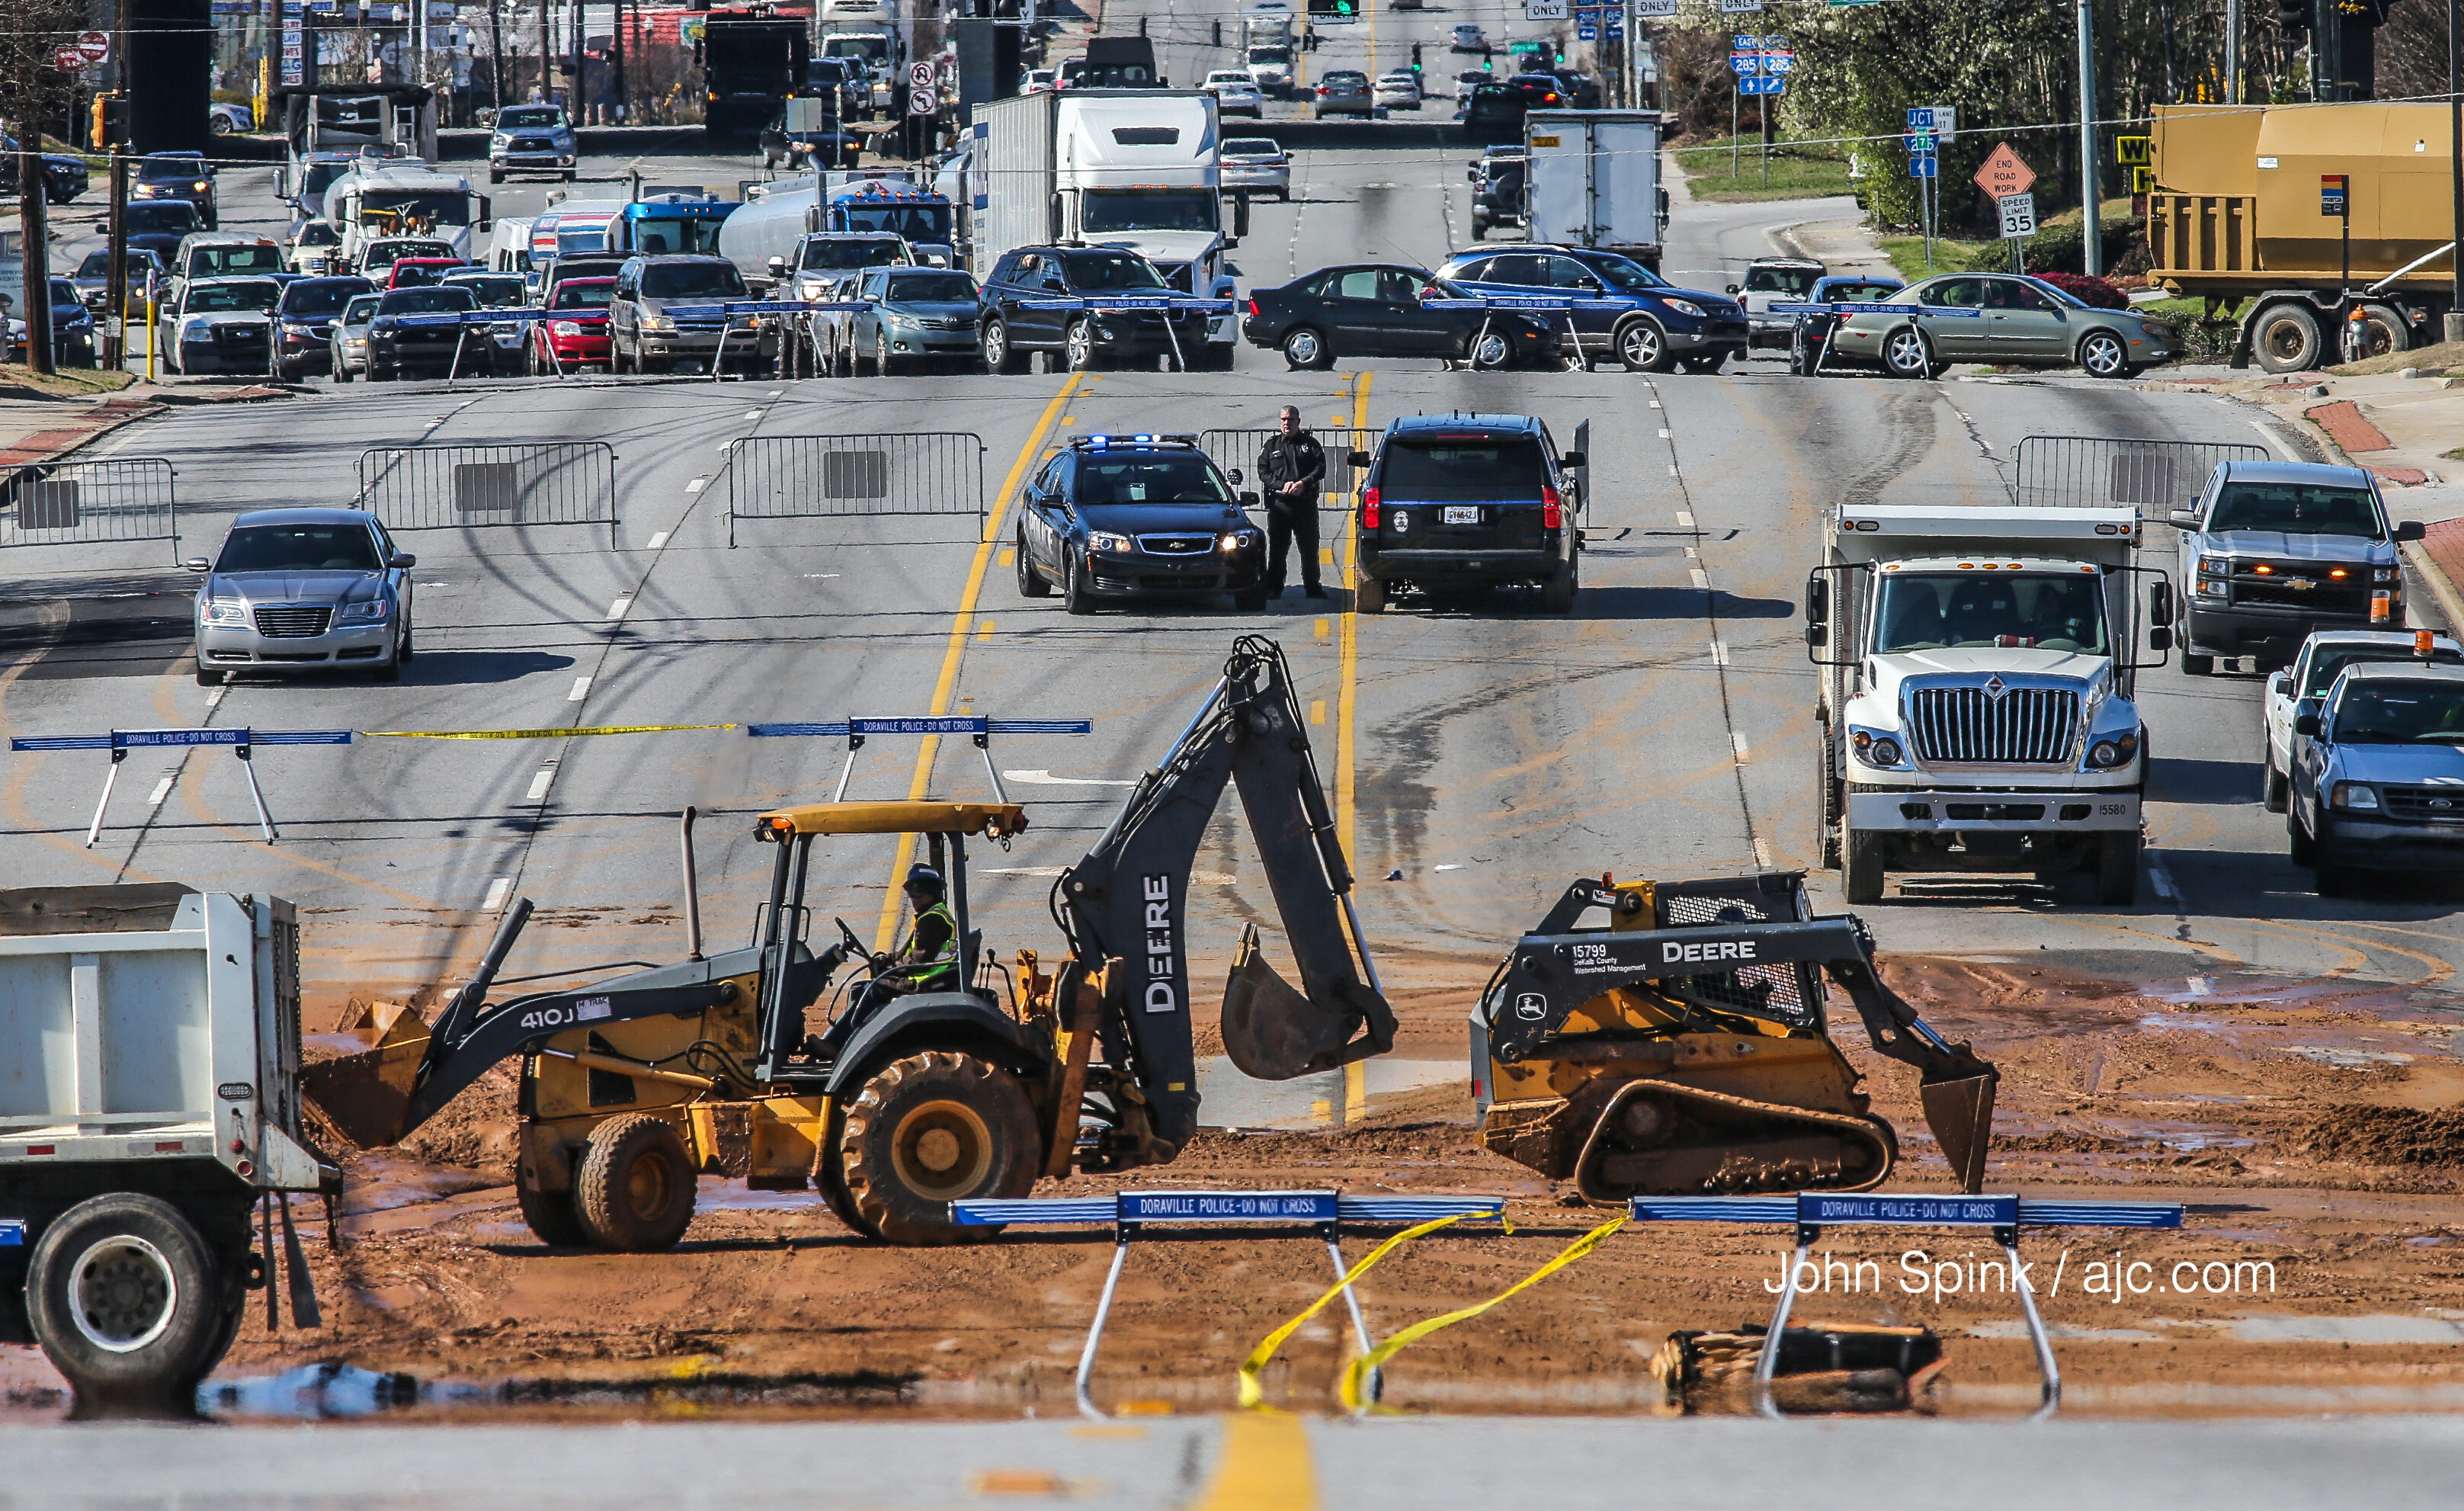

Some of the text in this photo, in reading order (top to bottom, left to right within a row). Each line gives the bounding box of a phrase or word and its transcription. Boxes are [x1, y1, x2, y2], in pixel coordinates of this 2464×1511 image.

[1533, 5, 1561, 15] ONLY
[1640, 1, 1669, 12] ONLY
[1725, 0, 1757, 8] ONLY
[1606, 11, 1622, 24] 85
[1738, 37, 1755, 47] EAST
[1736, 59, 1756, 72] 285
[1910, 111, 1932, 125] JCT
[1911, 138, 1934, 151] 25
[1919, 137, 1926, 146] 7
[1996, 160, 2012, 168] END
[1994, 172, 2016, 181] ROAD
[1994, 184, 2017, 193] WORK
[2001, 198, 2030, 207] SPEED
[2006, 207, 2028, 216] LIMIT
[2005, 216, 2032, 233] 35
[864, 721, 898, 732] DORAVILLE
[939, 720, 950, 730] NOT
[953, 720, 973, 730] CROSS
[127, 734, 159, 744] DORAVILLE
[200, 733, 213, 742] NOT
[215, 732, 236, 742] CROSS
[2099, 804, 2126, 816] 15580
[1143, 876, 1175, 1012] DEERE
[1572, 945, 1606, 958] 15799
[1662, 941, 1756, 963] DEERE
[1596, 957, 1617, 965] County
[1575, 963, 1646, 974] Watershed Management
[589, 996, 607, 1006] TRAC
[521, 1009, 574, 1028] 410J
[1140, 1198, 1194, 1214] DORAVILLE
[1259, 1198, 1280, 1214] NOT
[1283, 1198, 1317, 1214] CROSS
[1821, 1201, 1876, 1217] DORAVILLE
[1940, 1202, 1959, 1218] NOT
[1963, 1203, 1995, 1219] CROSS
